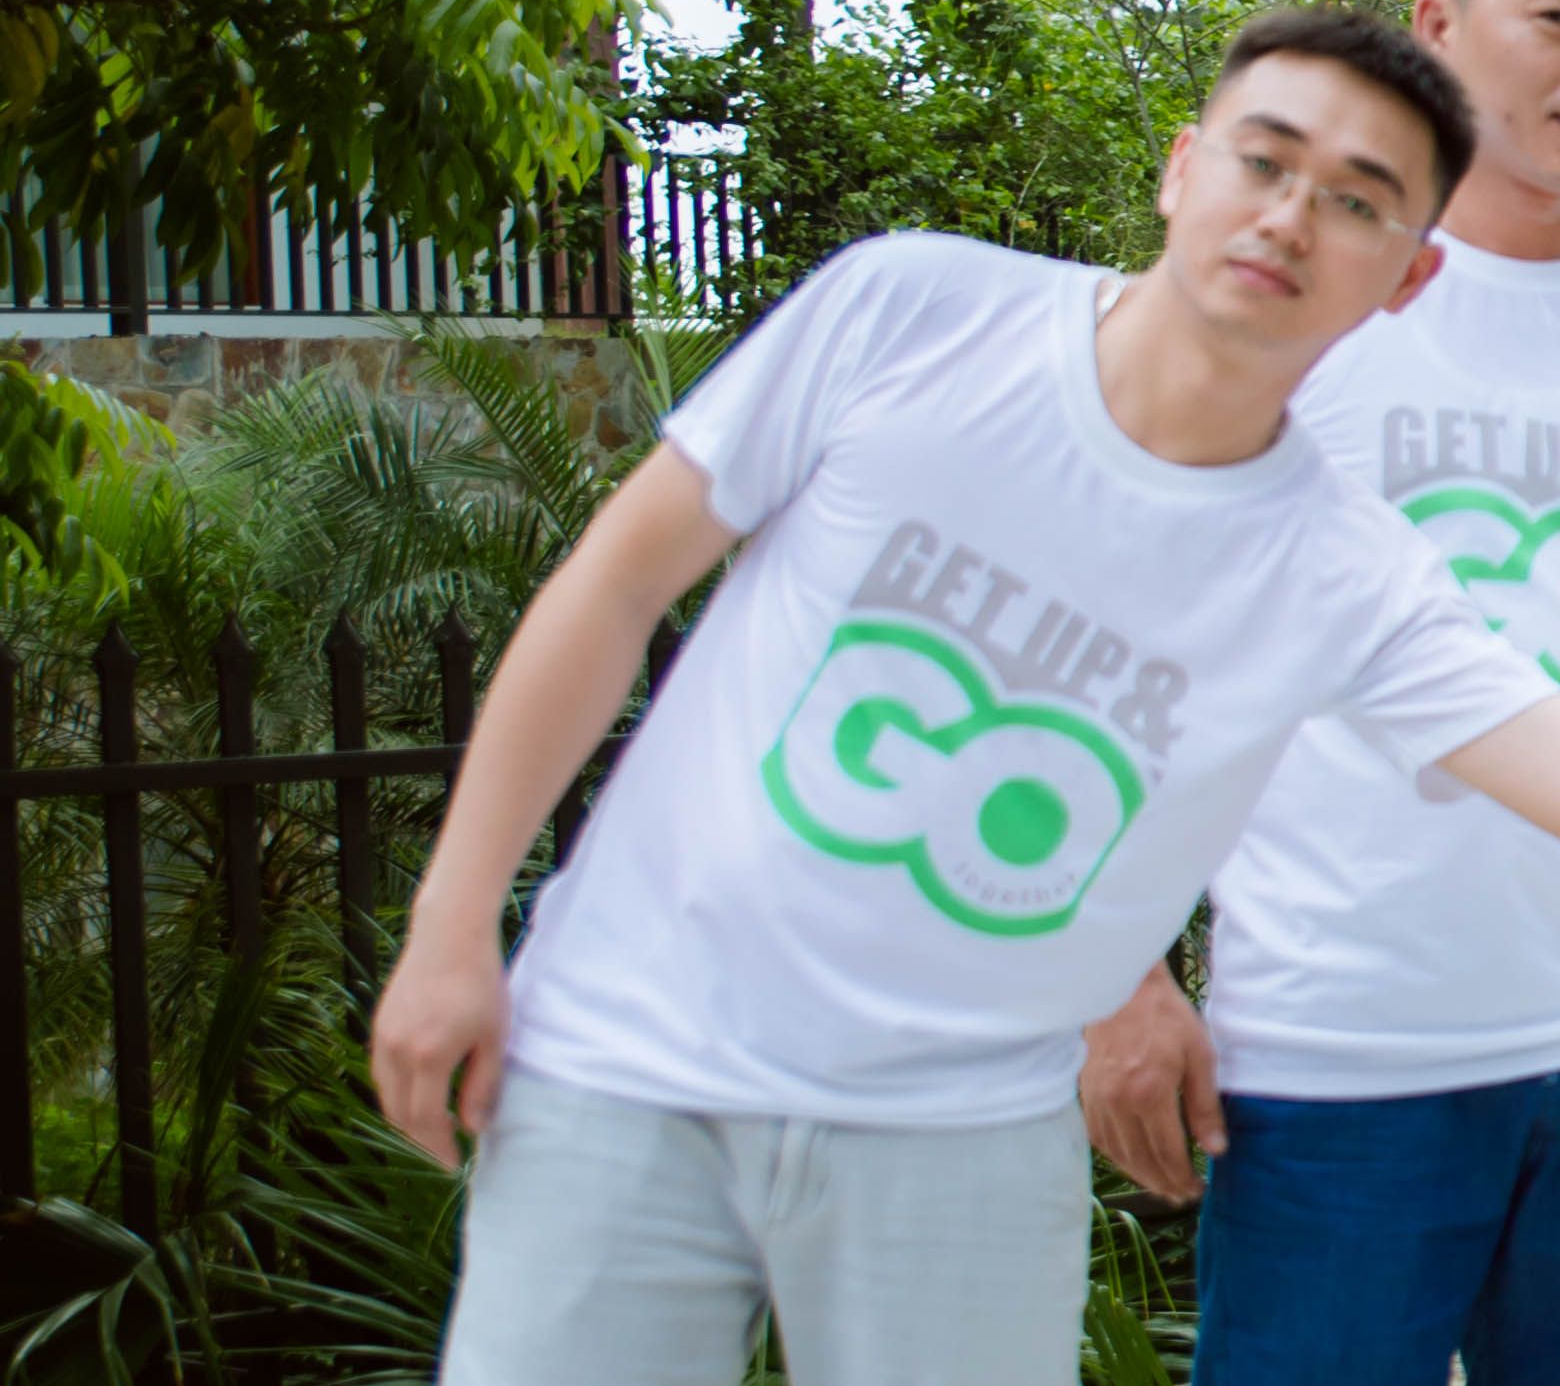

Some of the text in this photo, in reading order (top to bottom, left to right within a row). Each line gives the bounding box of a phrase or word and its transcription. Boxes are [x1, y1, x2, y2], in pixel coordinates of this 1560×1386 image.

[1382, 405, 1507, 501] GET
[849, 517, 1031, 648] GET
[761, 620, 1146, 938] GO
